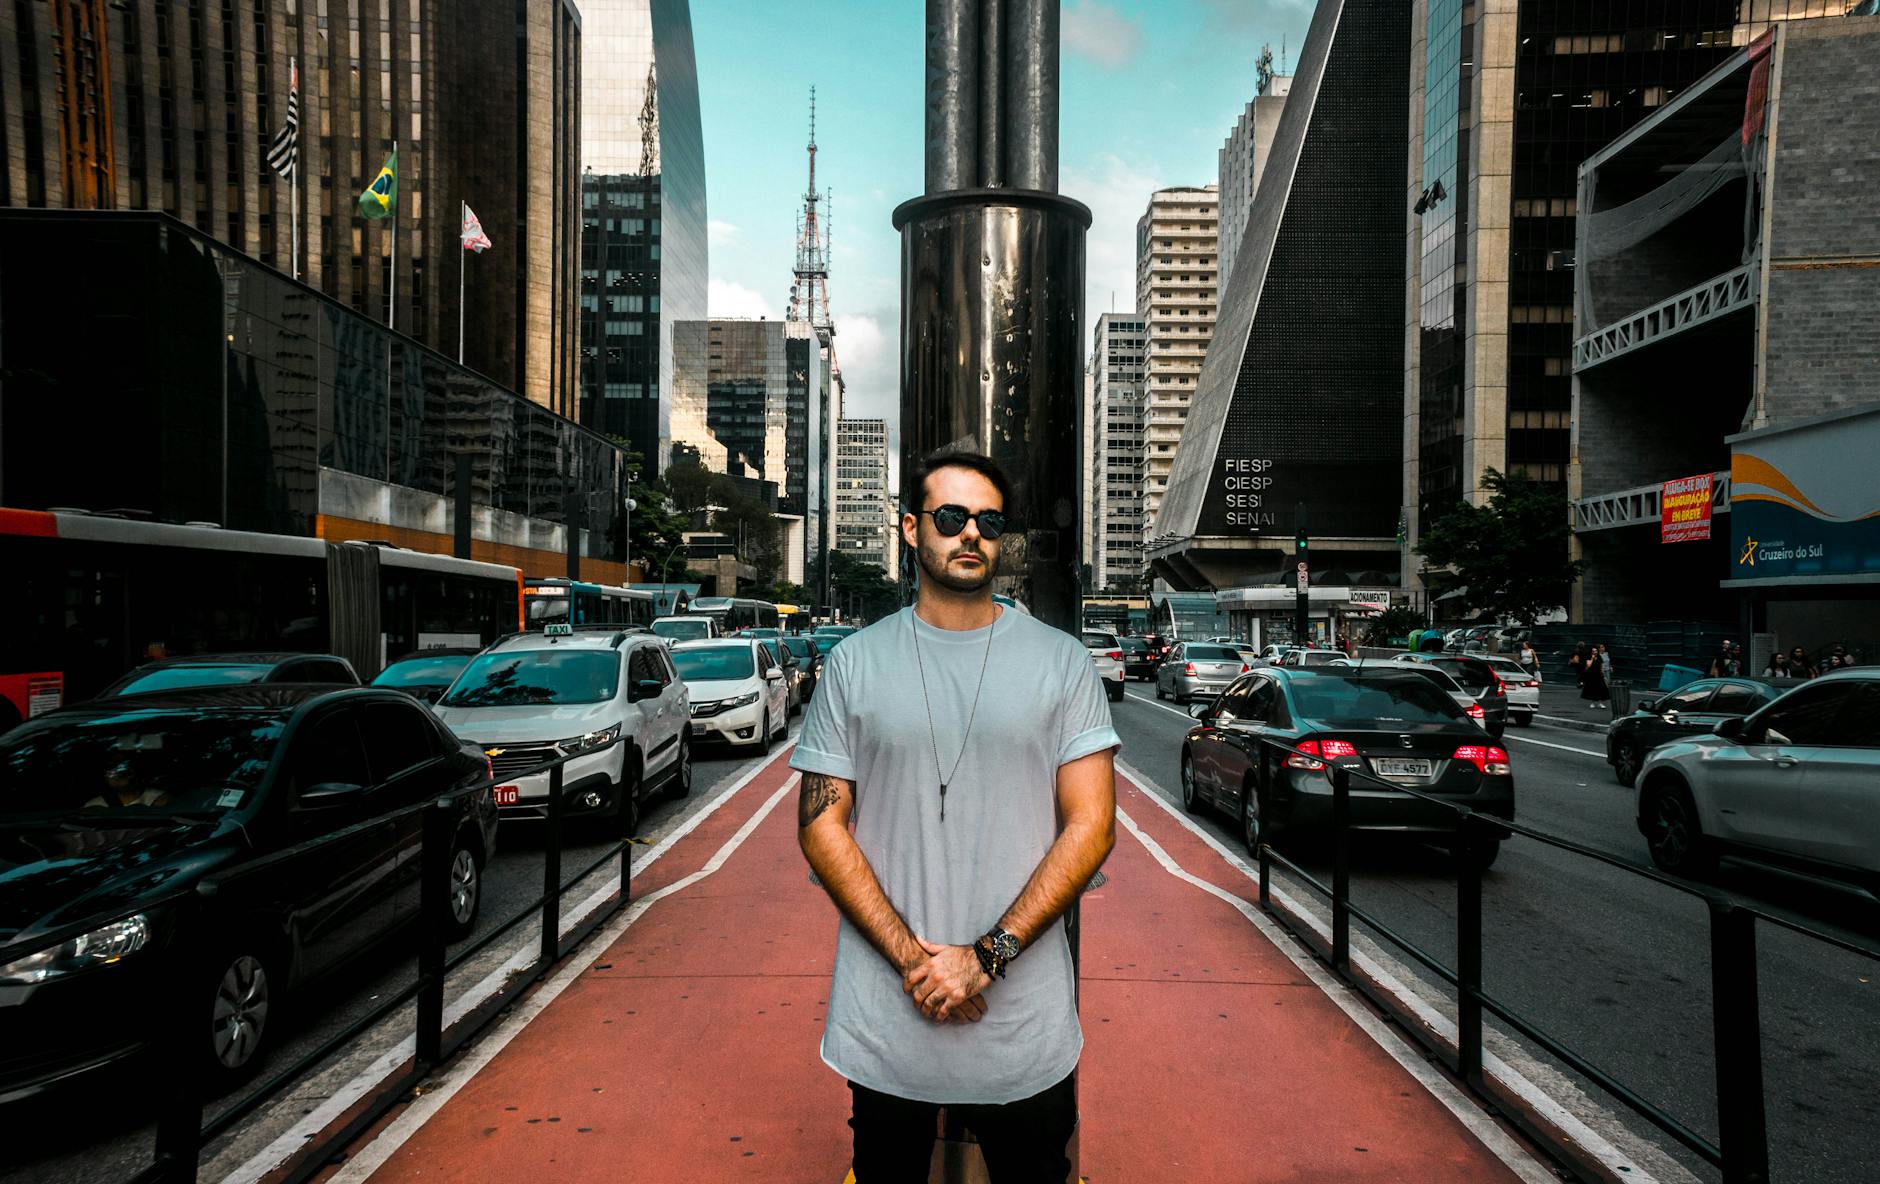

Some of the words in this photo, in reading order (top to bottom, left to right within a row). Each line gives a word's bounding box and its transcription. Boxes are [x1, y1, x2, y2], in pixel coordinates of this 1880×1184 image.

[1225, 459, 1272, 473] FIESP
[1225, 476, 1273, 490] CIESP
[1226, 494, 1262, 508] SESI
[1226, 512, 1275, 525] SENAI
[1672, 510, 1681, 522] EM
[1682, 508, 1701, 521] BREVE
[1759, 547, 1794, 561] Cruzeiro
[1795, 546, 1807, 558] do
[1808, 544, 1823, 557] Sul
[548, 625, 568, 634] TAXI
[495, 791, 516, 802] 110
